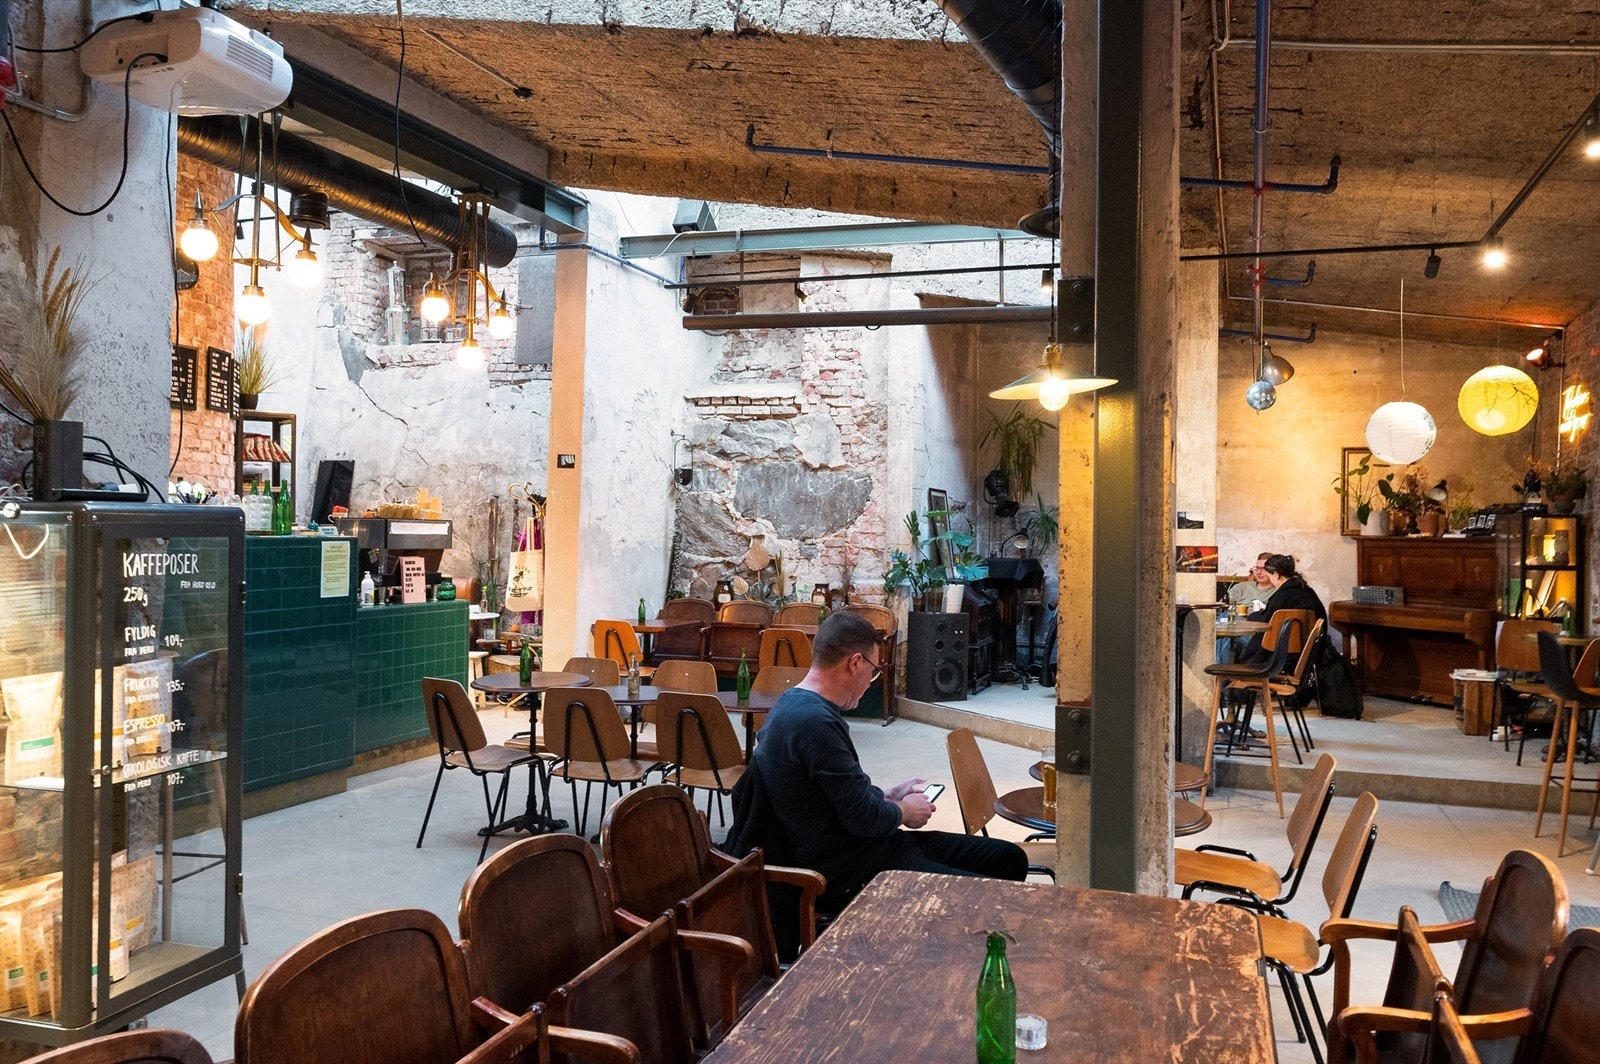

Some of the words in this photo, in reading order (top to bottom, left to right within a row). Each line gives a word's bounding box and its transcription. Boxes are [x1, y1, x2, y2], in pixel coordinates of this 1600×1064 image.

[123, 552, 200, 578] KAFFEPOSER
[123, 587, 149, 607] 250g
[124, 625, 157, 643] FYLDIG
[124, 677, 160, 693] FRUKTIG
[124, 714, 166, 735] ESPRESSO
[122, 756, 173, 779] ØKOLOGISK
[176, 751, 199, 766] KAFFE
